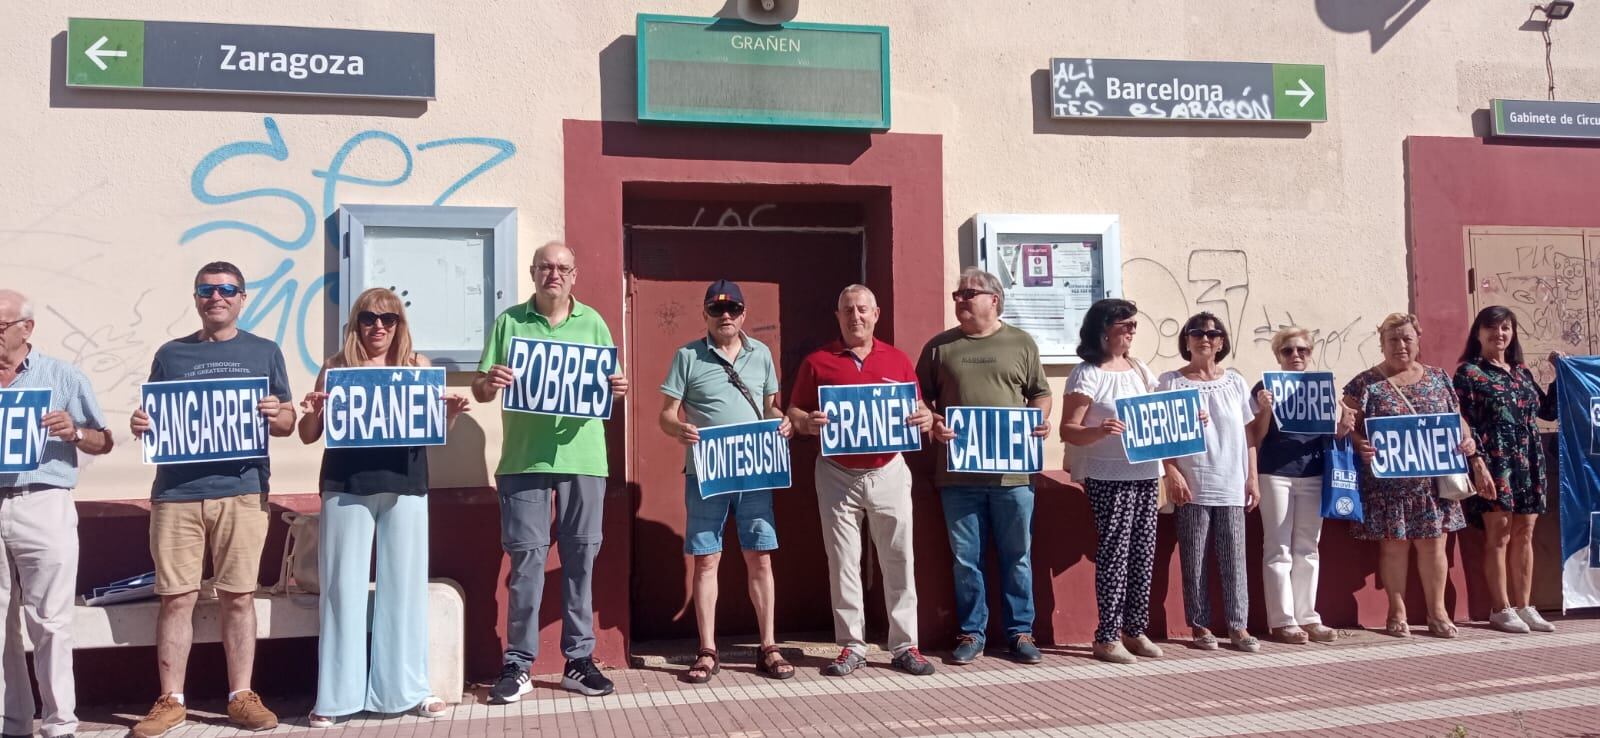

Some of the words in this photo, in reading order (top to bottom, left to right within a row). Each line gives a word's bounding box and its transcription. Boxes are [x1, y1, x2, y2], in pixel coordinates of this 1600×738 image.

[220, 44, 364, 79] Zaragoza
[731, 34, 800, 52] GRAÑEN
[1055, 100, 1103, 116] TES
[1106, 77, 1223, 101] Barcelona
[1510, 112, 1556, 124] Gabinete
[1560, 114, 1573, 124] de
[508, 341, 611, 416] ROBRES
[1271, 379, 1336, 421] ROBRES
[145, 388, 266, 458] SANGARREN
[950, 408, 1039, 471] CALLEN
[1124, 397, 1202, 449] ALBERUELA
[1371, 416, 1466, 474] GRAÑÉN
[694, 431, 788, 482] MONTESUSIN
